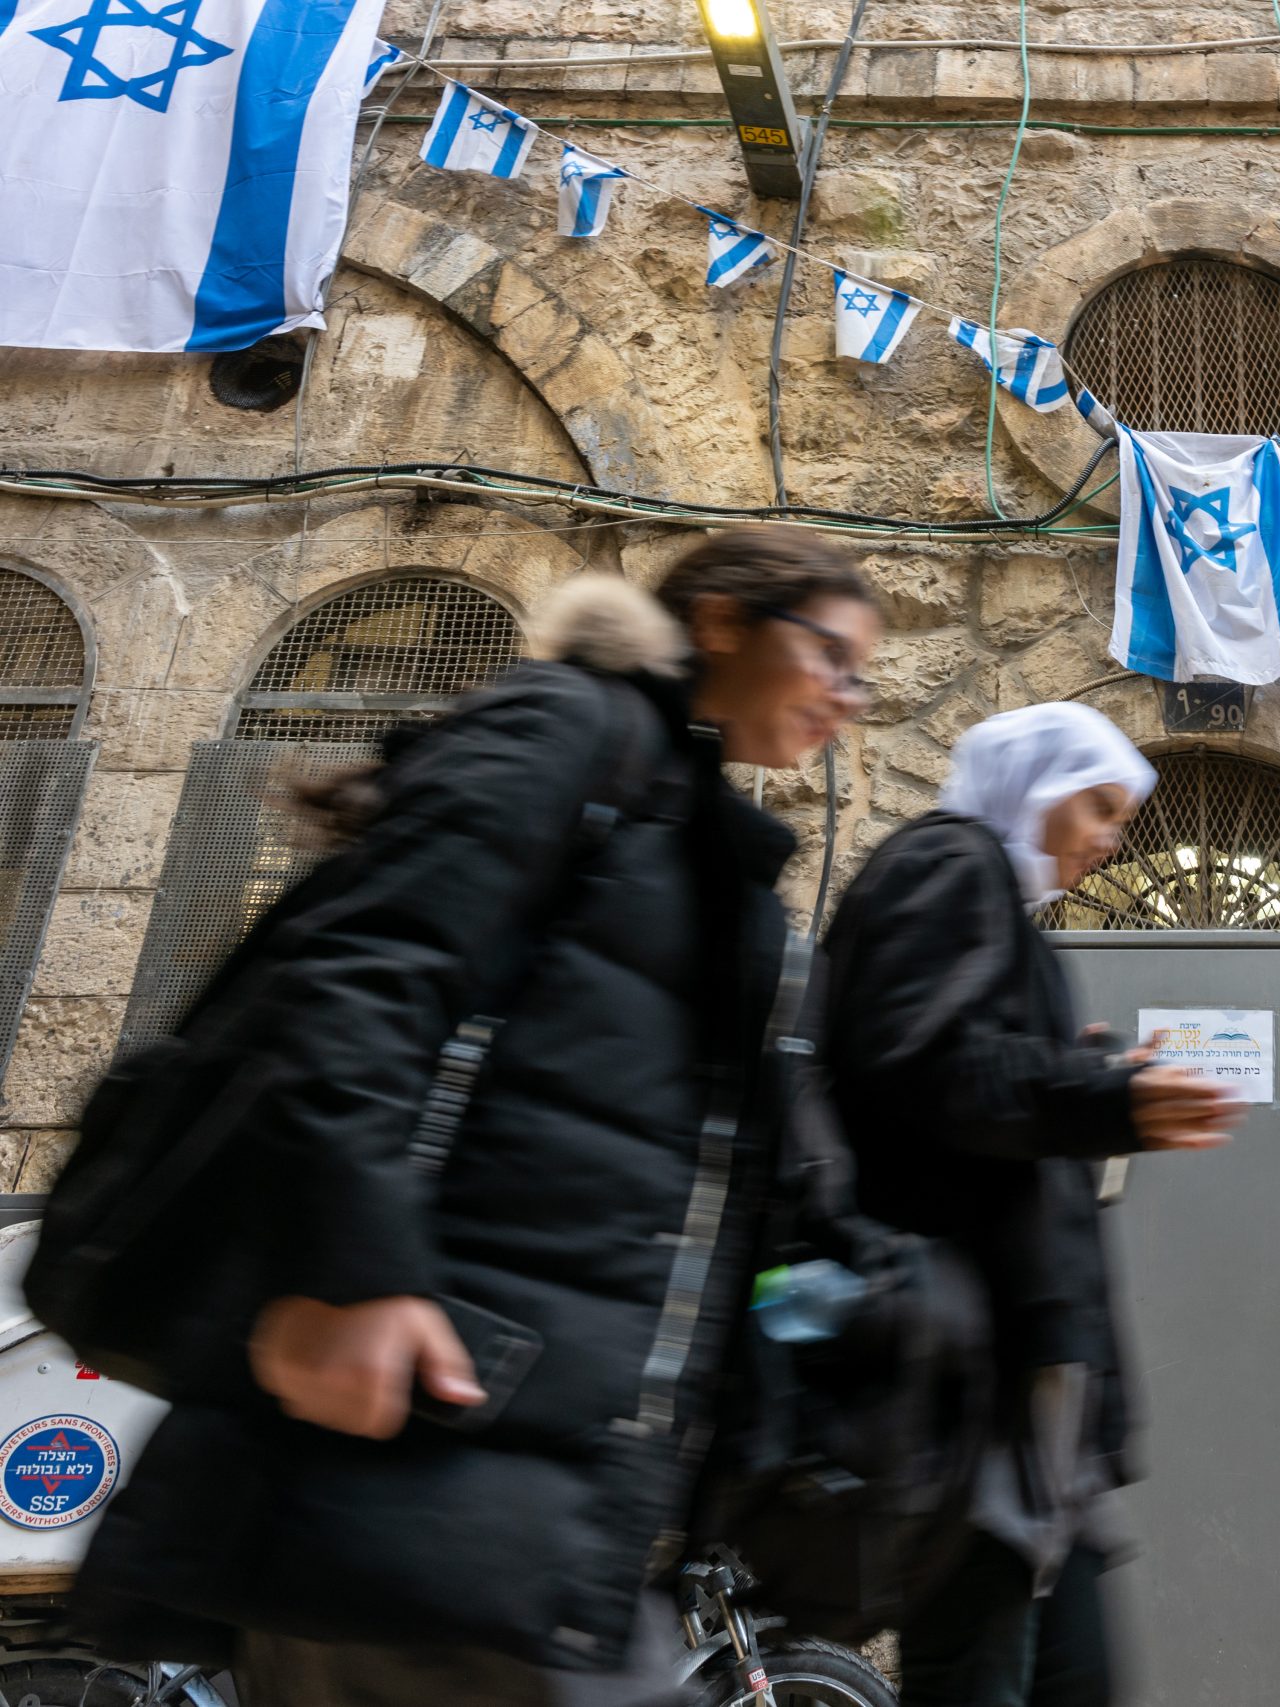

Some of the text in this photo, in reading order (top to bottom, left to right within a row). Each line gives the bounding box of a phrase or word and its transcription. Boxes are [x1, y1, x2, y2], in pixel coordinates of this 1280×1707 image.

[744, 127, 783, 144] 545
[1208, 704, 1244, 725] 90
[50, 1418, 79, 1427] SANS
[80, 1421, 116, 1467] FRONTIERES
[38, 1450, 76, 1461] הצלה
[16, 1463, 93, 1475] ללא גבולות
[25, 1477, 113, 1525] WITHOUT BORDERS
[29, 1495, 69, 1511] SSF
